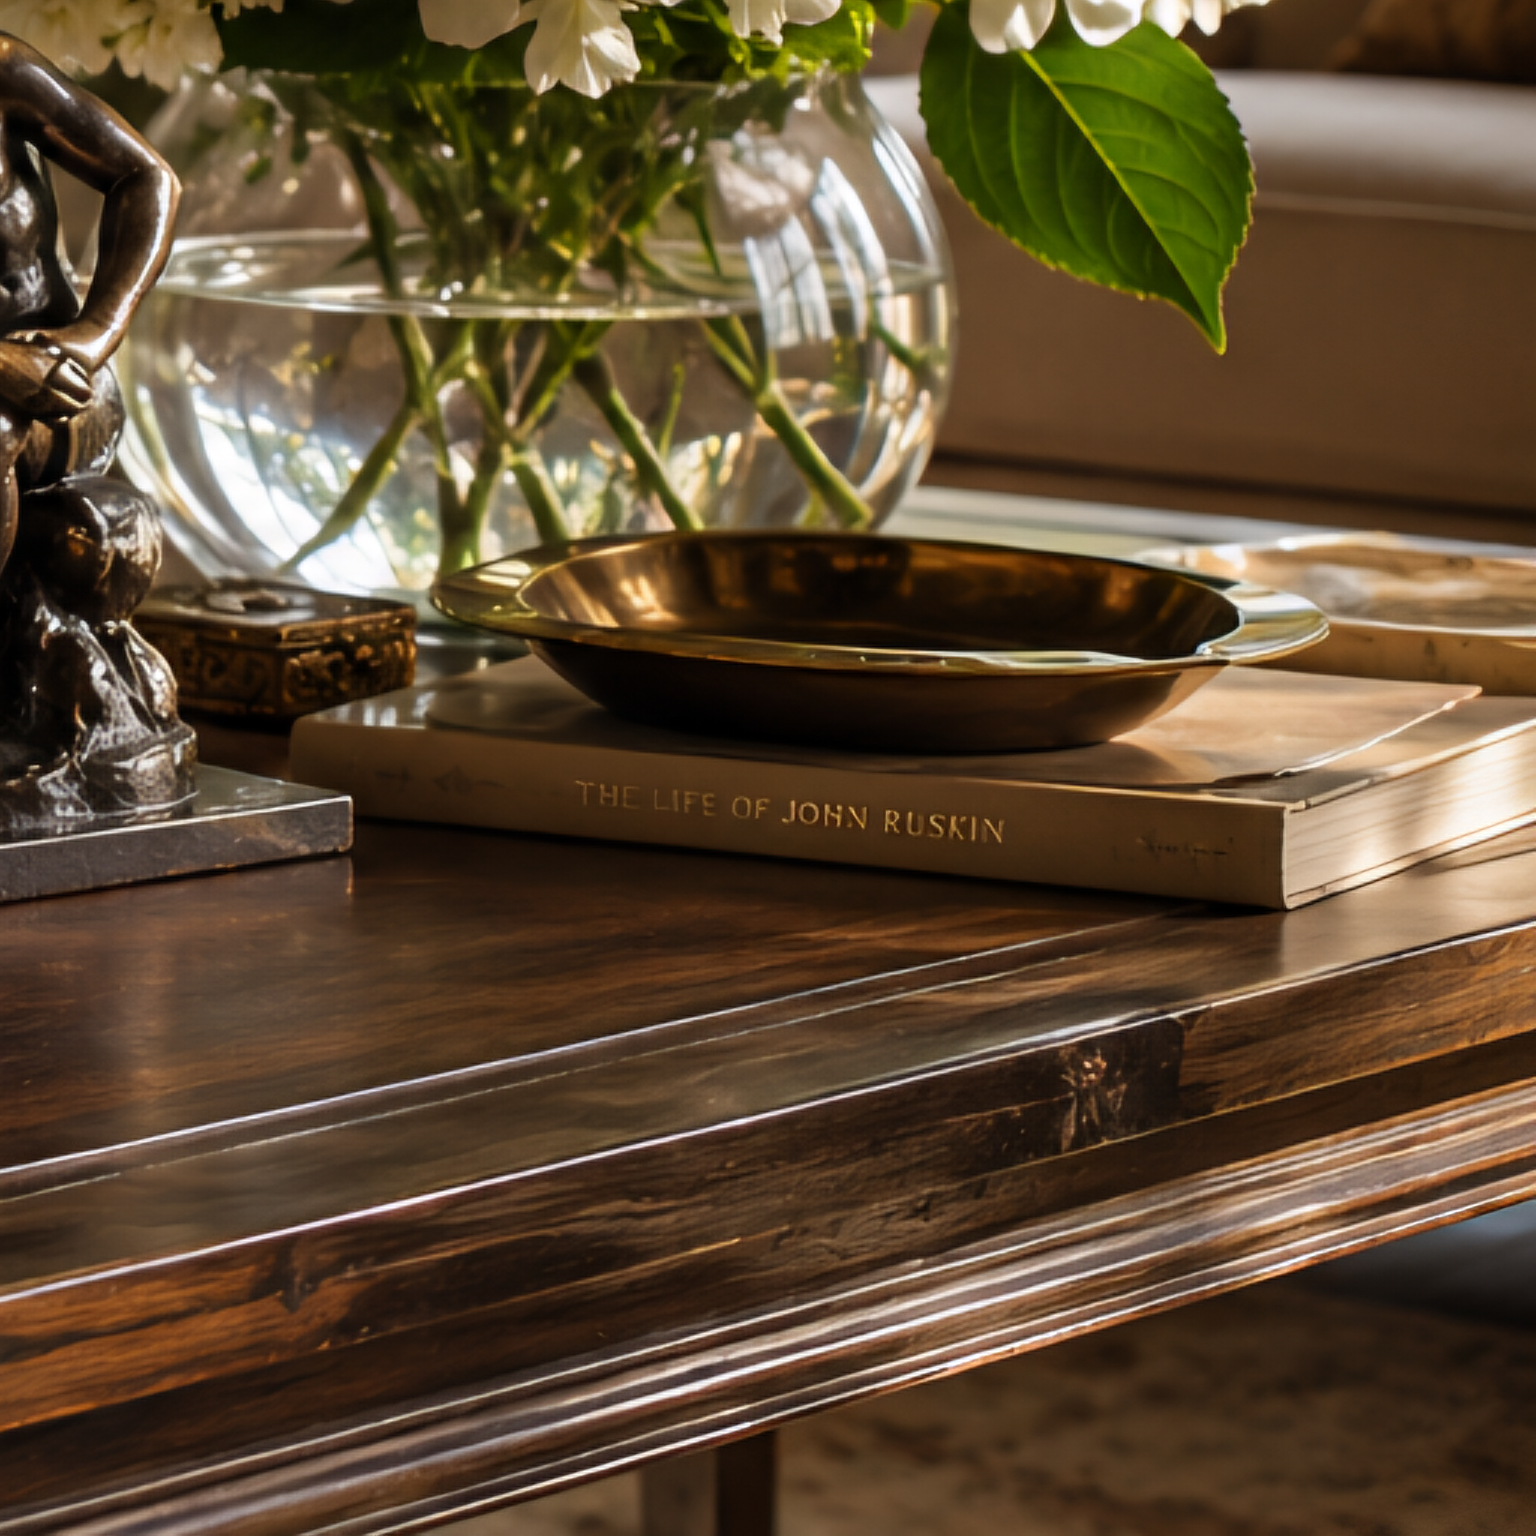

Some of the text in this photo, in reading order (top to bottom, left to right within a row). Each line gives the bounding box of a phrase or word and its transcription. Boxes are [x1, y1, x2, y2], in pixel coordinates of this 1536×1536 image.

[574, 779, 1006, 845] THE LIFE OF JOHN RUSKIN
